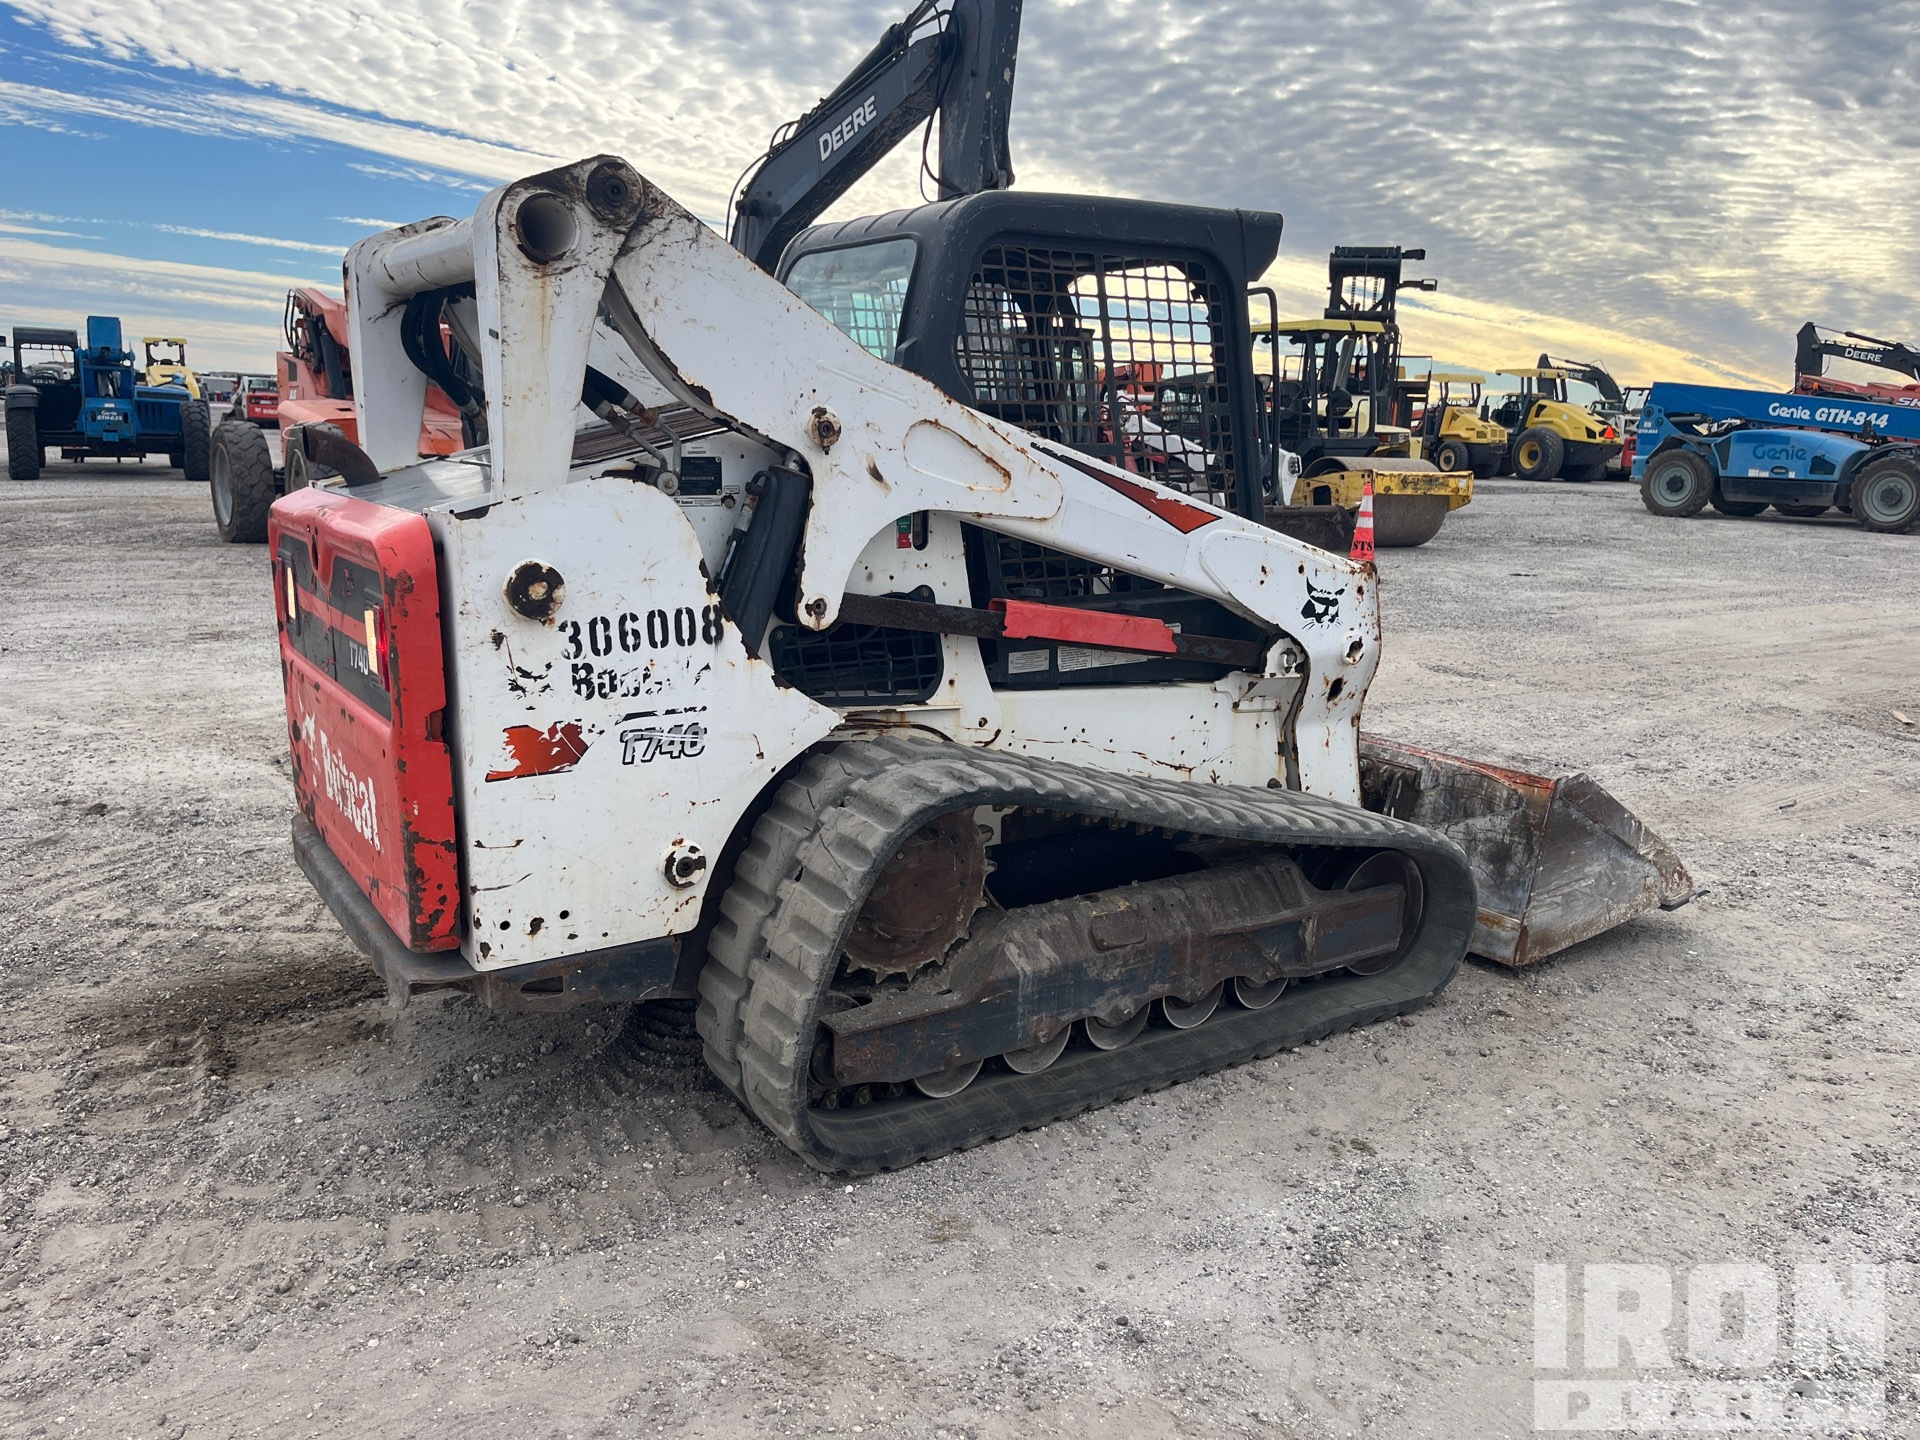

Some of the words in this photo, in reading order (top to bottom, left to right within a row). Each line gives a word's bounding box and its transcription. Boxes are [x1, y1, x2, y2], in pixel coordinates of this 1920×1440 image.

[819, 94, 877, 162] DEERE
[1844, 347, 1883, 363] DEERE
[1768, 402, 1811, 420] Genie
[1815, 407, 1889, 429] GTH-844
[1752, 443, 1808, 461] Genie
[1352, 540, 1373, 552] STS
[558, 604, 724, 660] 306008
[349, 641, 369, 676] T740
[619, 721, 708, 766] T740
